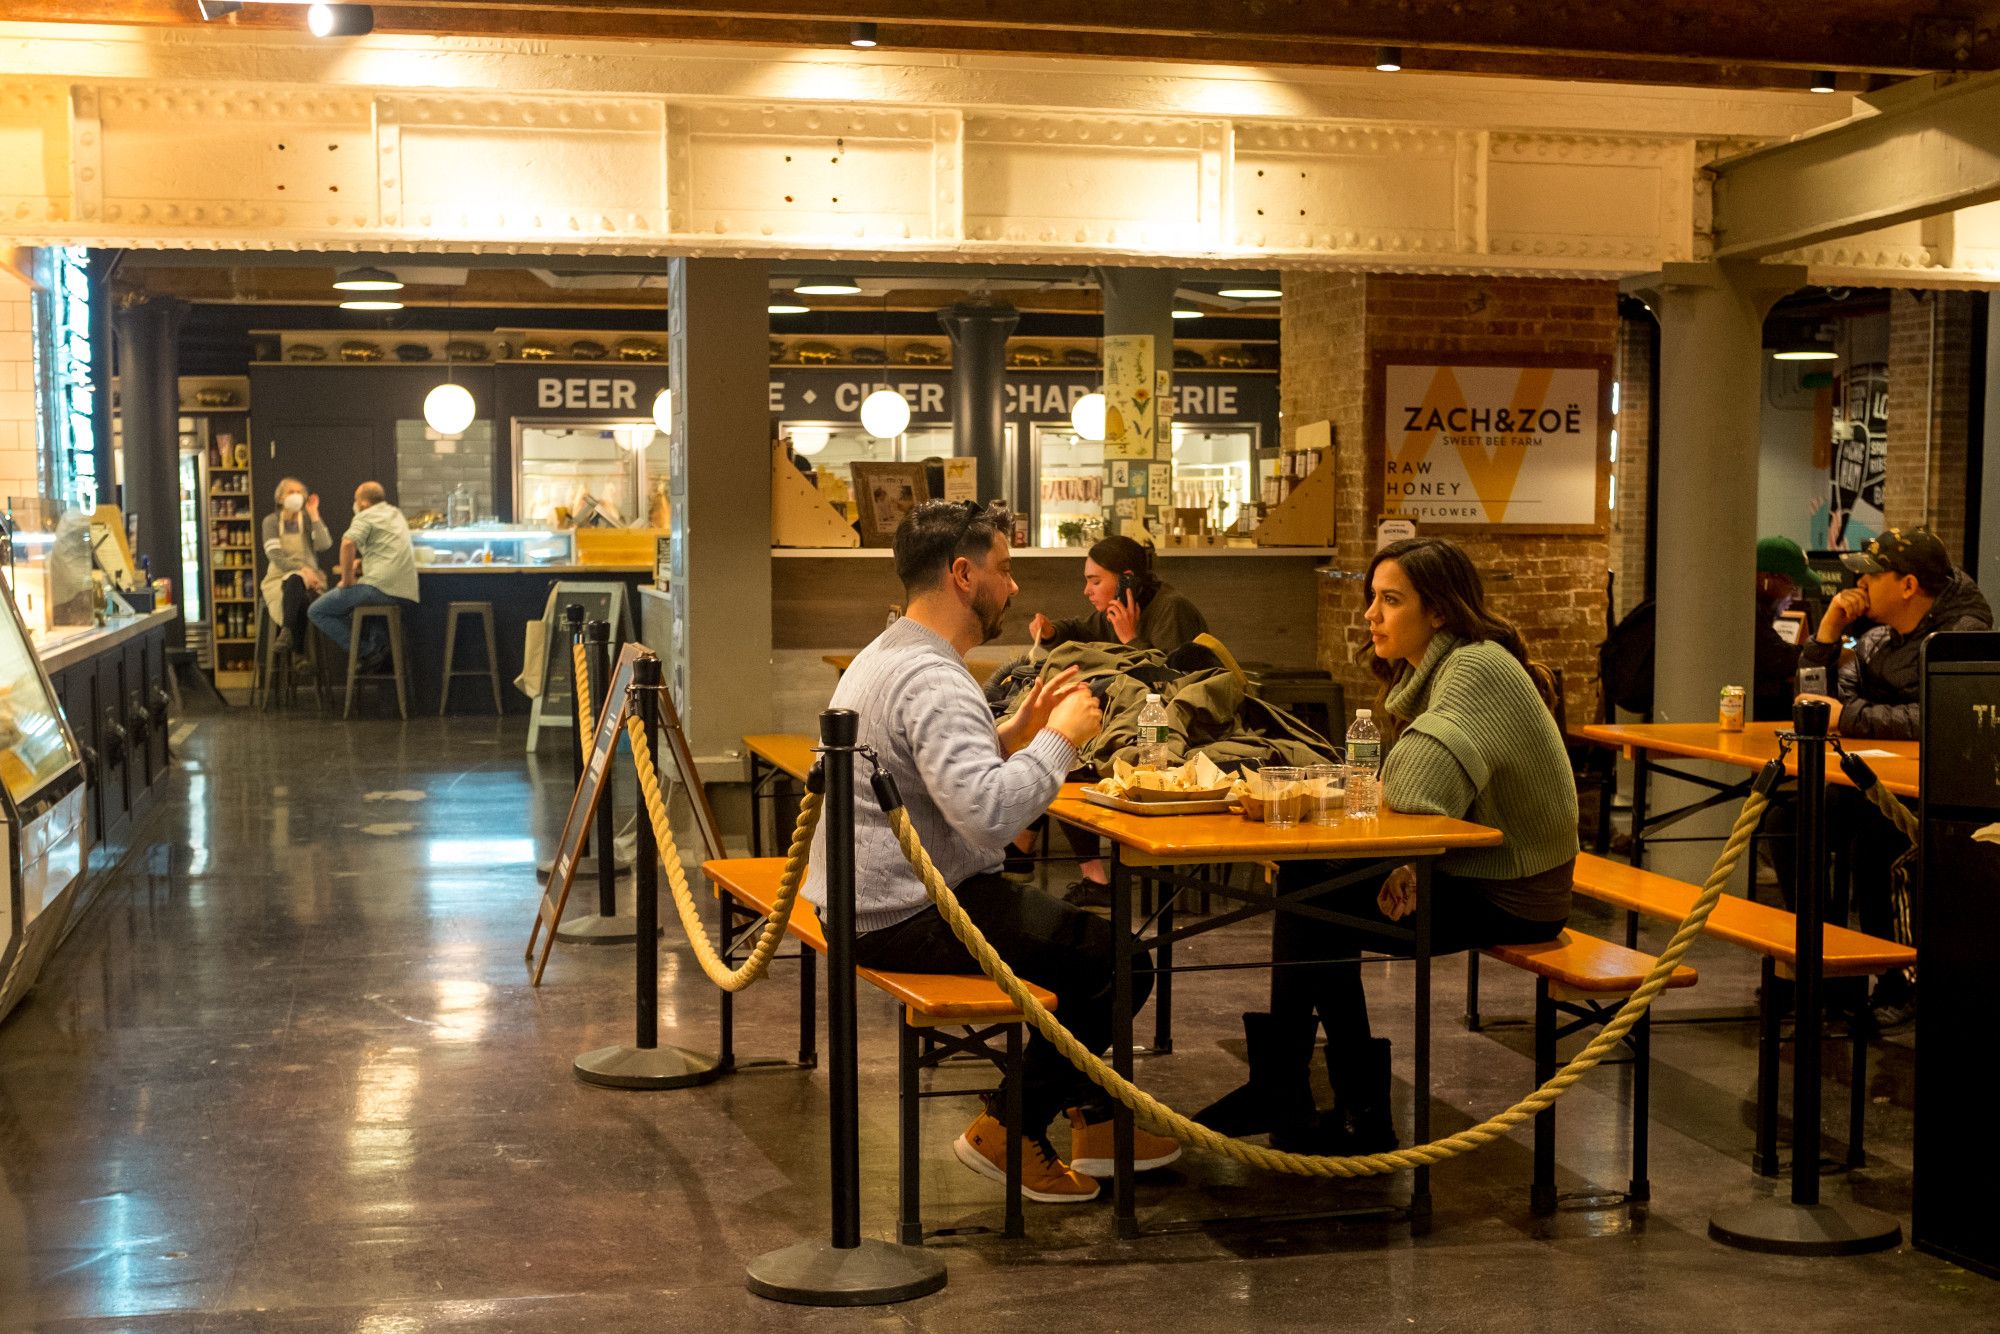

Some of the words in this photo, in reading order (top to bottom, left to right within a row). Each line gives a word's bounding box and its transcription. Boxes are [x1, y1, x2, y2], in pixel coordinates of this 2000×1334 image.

[537, 378, 638, 410] BEER
[834, 382, 945, 413] CIER
[1403, 404, 1581, 433] ZACH&ZOË
[1443, 436, 1481, 447] SWEET
[1486, 437, 1506, 447] BEE
[1511, 437, 1543, 447] FARM
[1387, 461, 1432, 474] RAW
[1386, 482, 1462, 496] HONEY
[1385, 507, 1478, 517] WILDFLOWER
